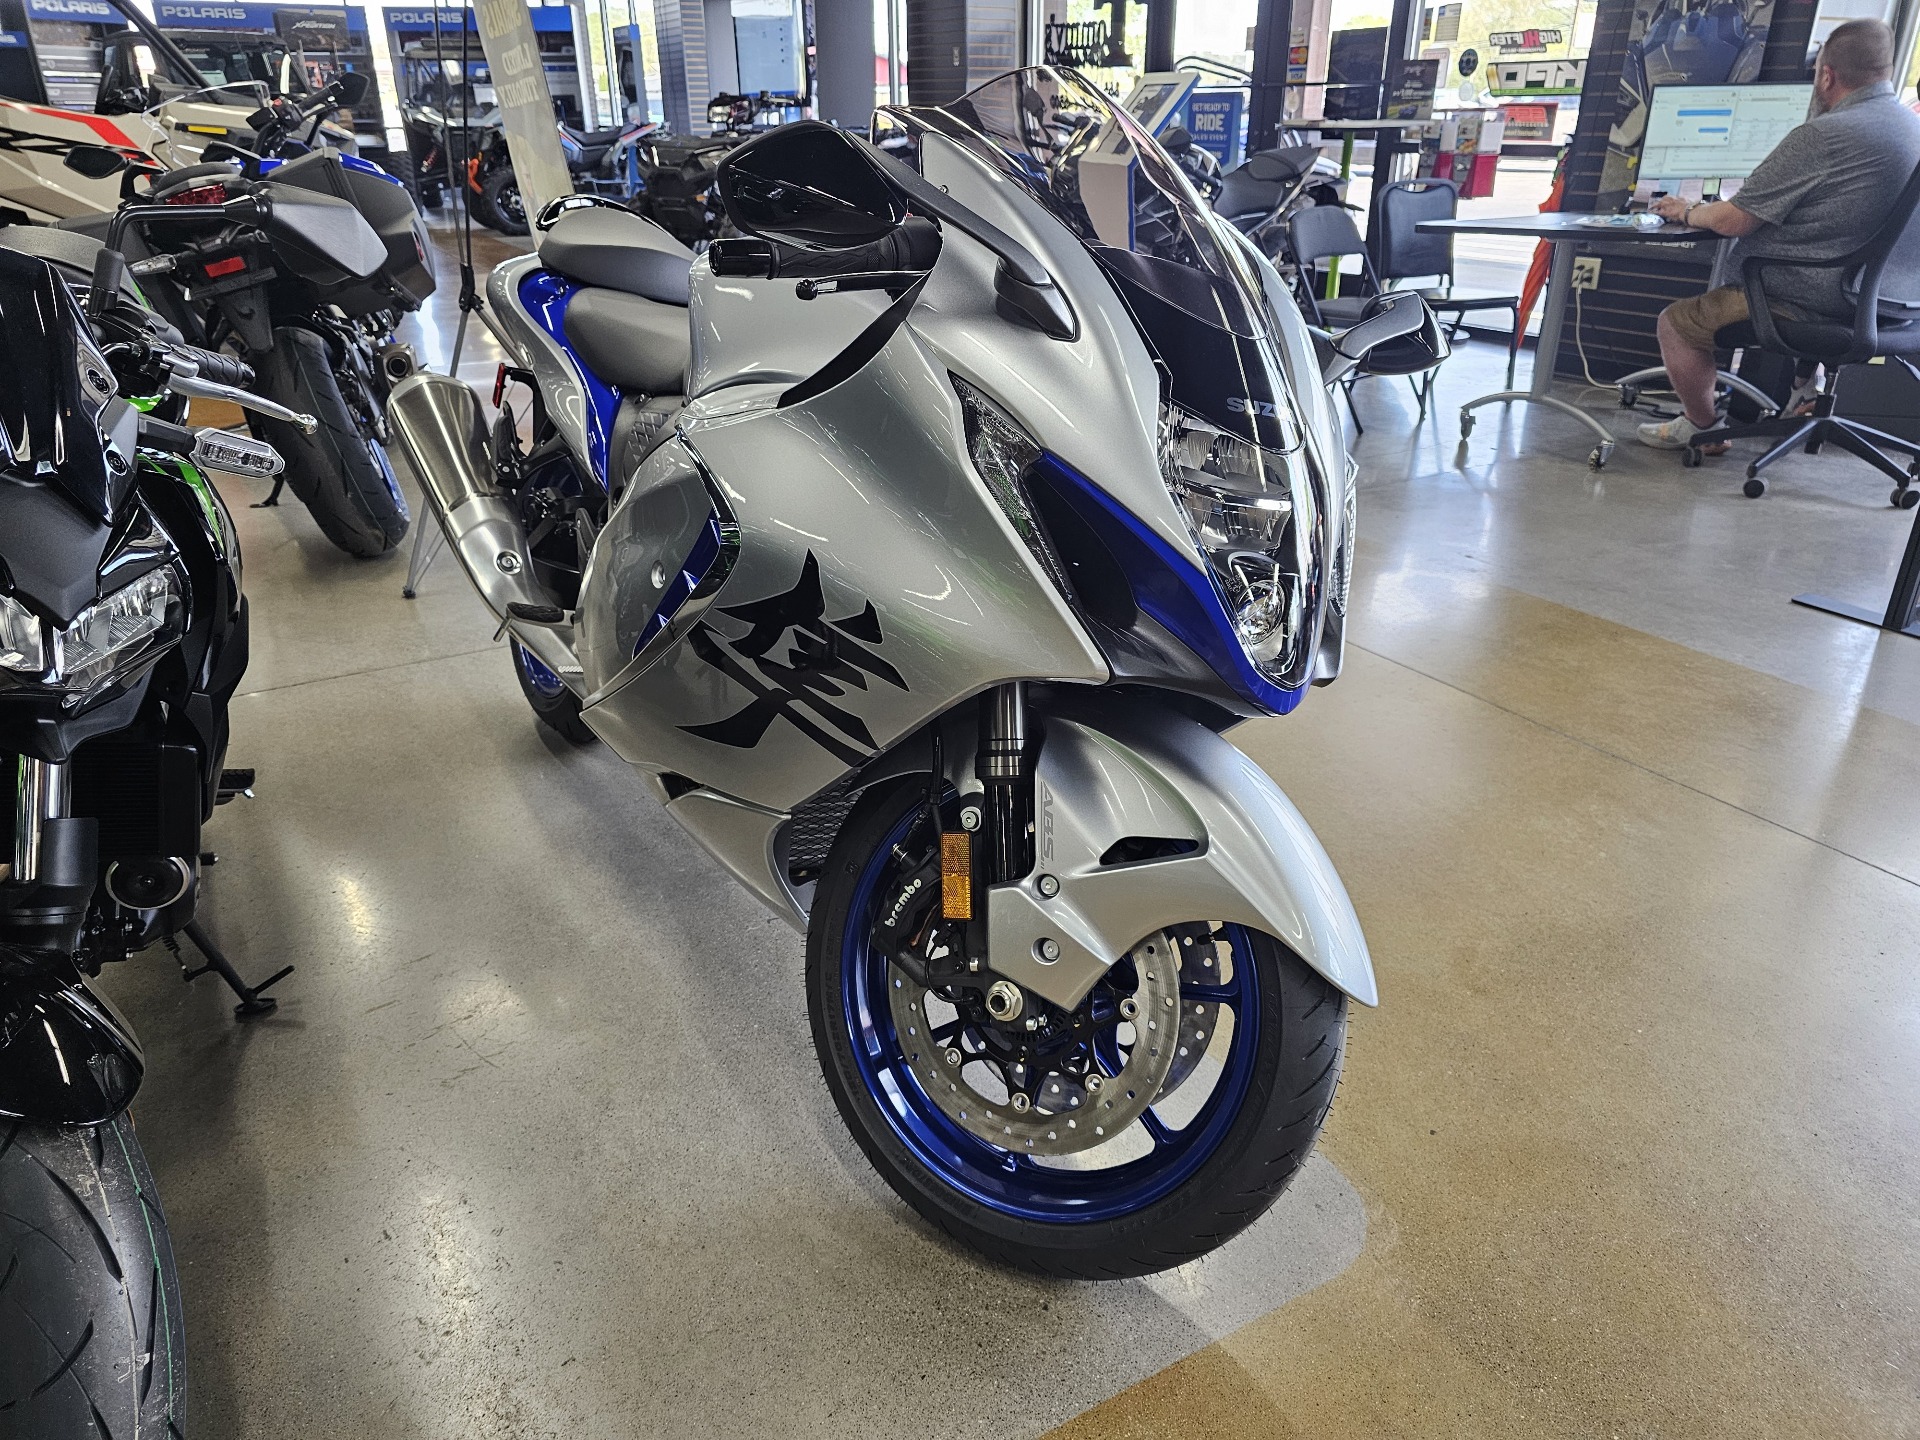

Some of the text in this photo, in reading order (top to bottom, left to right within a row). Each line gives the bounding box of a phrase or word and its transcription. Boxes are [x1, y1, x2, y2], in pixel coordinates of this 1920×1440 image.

[31, 0, 110, 15] POLARIS
[161, 5, 247, 20] POLARIS
[389, 12, 464, 24] POLARIS
[1195, 113, 1225, 132] RIDE
[1041, 780, 1054, 862] ABS
[884, 878, 922, 927] brembo
